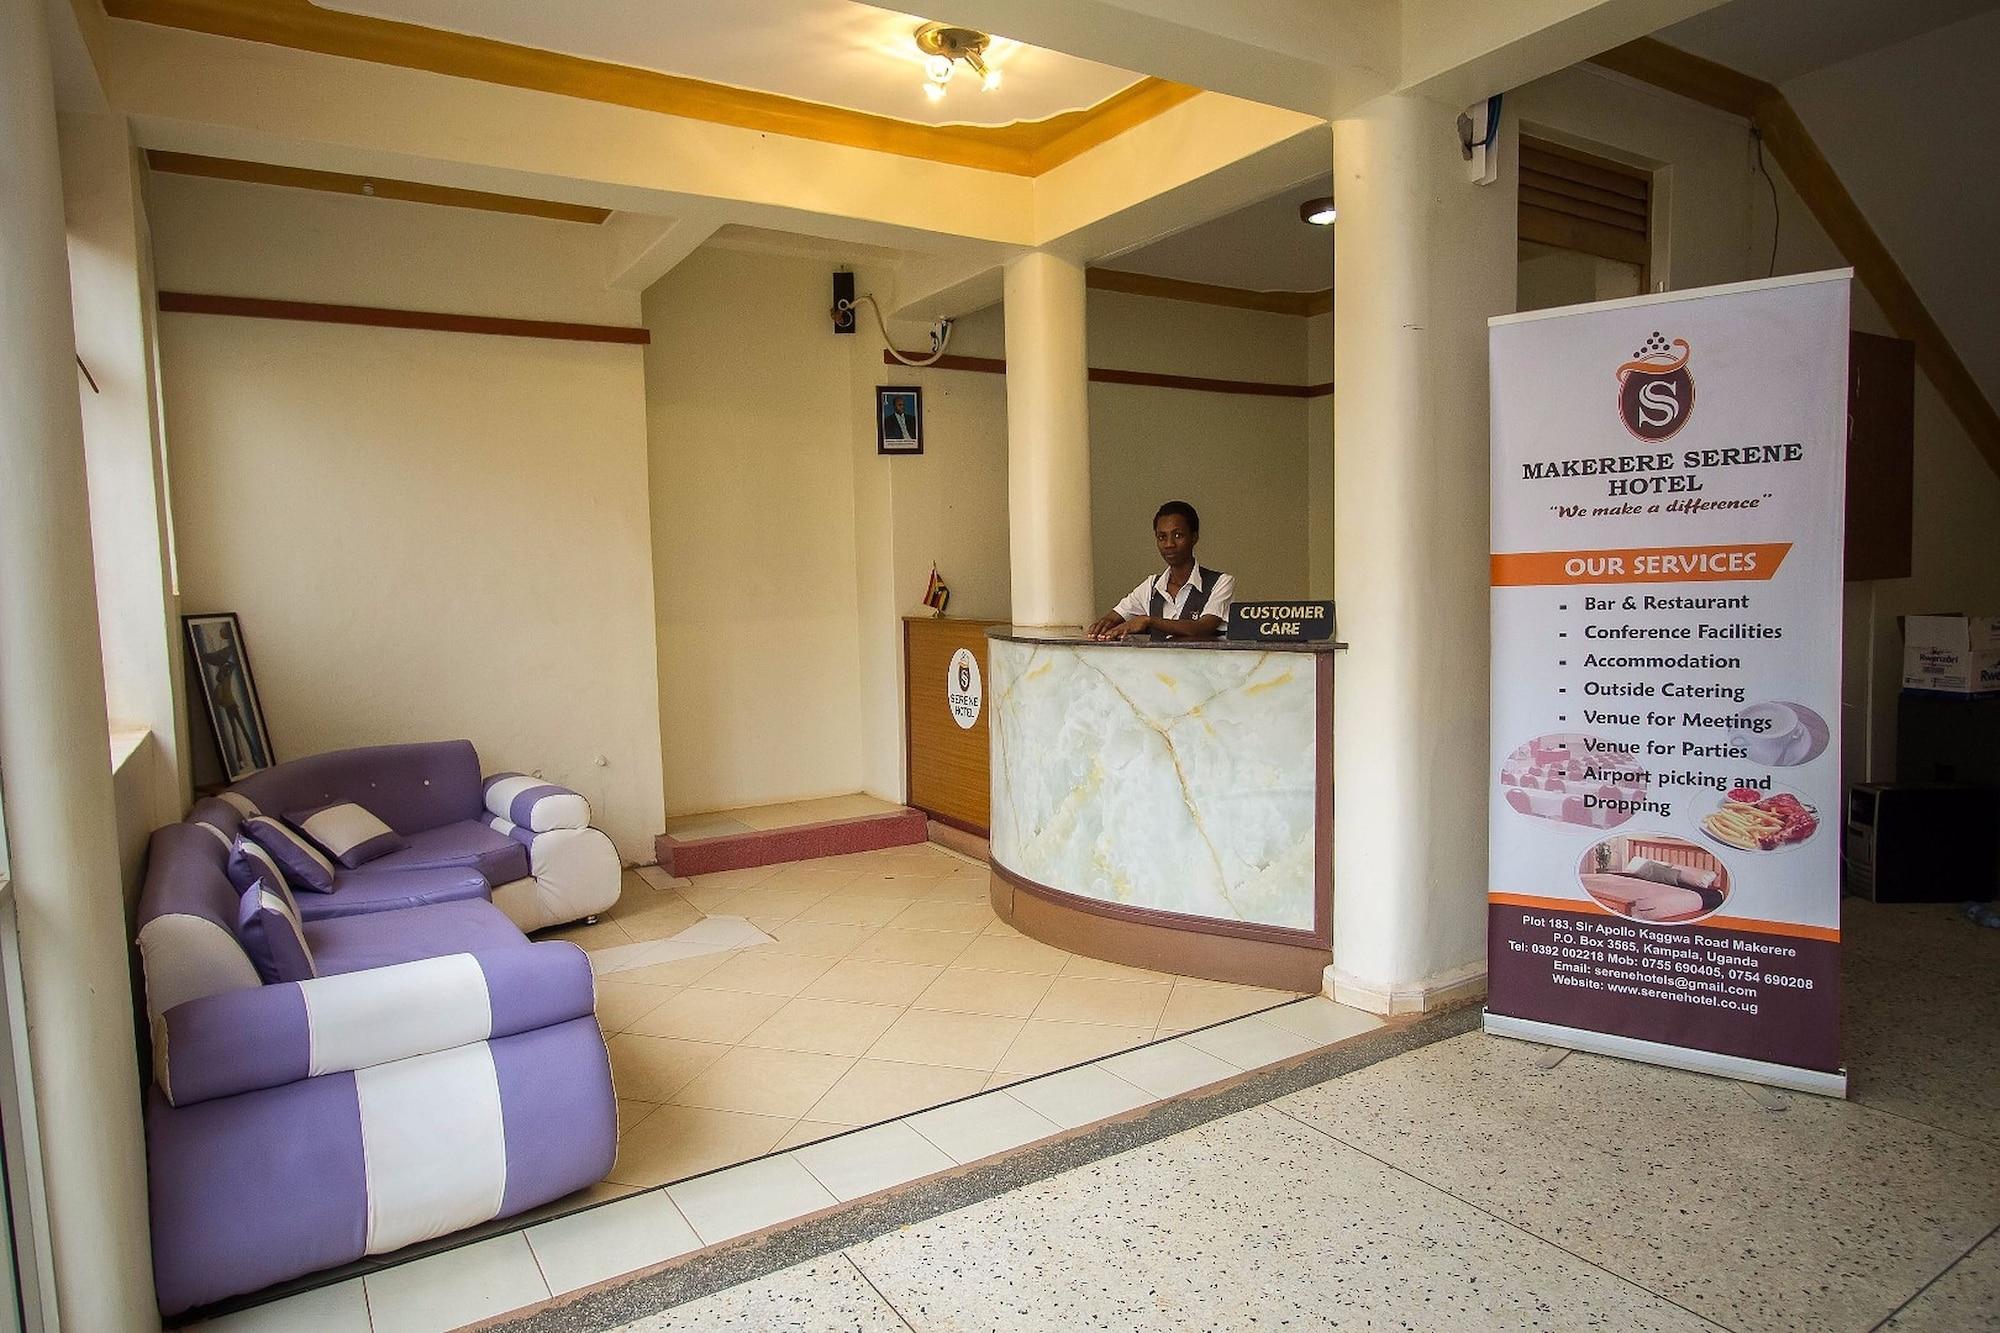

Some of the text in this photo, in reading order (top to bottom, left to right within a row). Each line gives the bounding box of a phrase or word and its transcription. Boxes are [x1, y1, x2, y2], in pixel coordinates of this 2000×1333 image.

[1522, 444, 1802, 479] MAKERERE SERENE
[1608, 475, 1703, 496] HOTEL
[1593, 502, 1642, 516] make
[1648, 505, 1659, 513] a
[1565, 553, 1757, 576] OUR SERVICES
[1240, 607, 1324, 619] CUSTOMER
[1585, 595, 1749, 611] Bar & Restaurant
[1260, 623, 1300, 635] CARE
[1585, 624, 1782, 639] Conference Facilities
[1584, 654, 1740, 669] Accommodation
[950, 694, 978, 706] SERENE
[1584, 682, 1744, 702] Outside Catering
[955, 706, 974, 717] HOTEL
[1584, 711, 1772, 732] Venue for Meetings
[1584, 739, 1747, 758] Venue for Parties
[1584, 767, 1770, 790] Airport picking and
[1584, 795, 1671, 816] Dropping
[1523, 915, 1796, 957] Plot 183, Sir Apollo Kaggwa Road Makerere
[1554, 933, 1758, 967] P.O. Box 3565, Kampala, Uganda
[1509, 941, 1813, 989] Tel: 0392 002218 Mob: 0755 690405, 0754 690208
[1554, 961, 1757, 997] Email: serenehotels@gmail.com
[1552, 974, 1758, 1015] Website: www.serenehotel.co.ug
